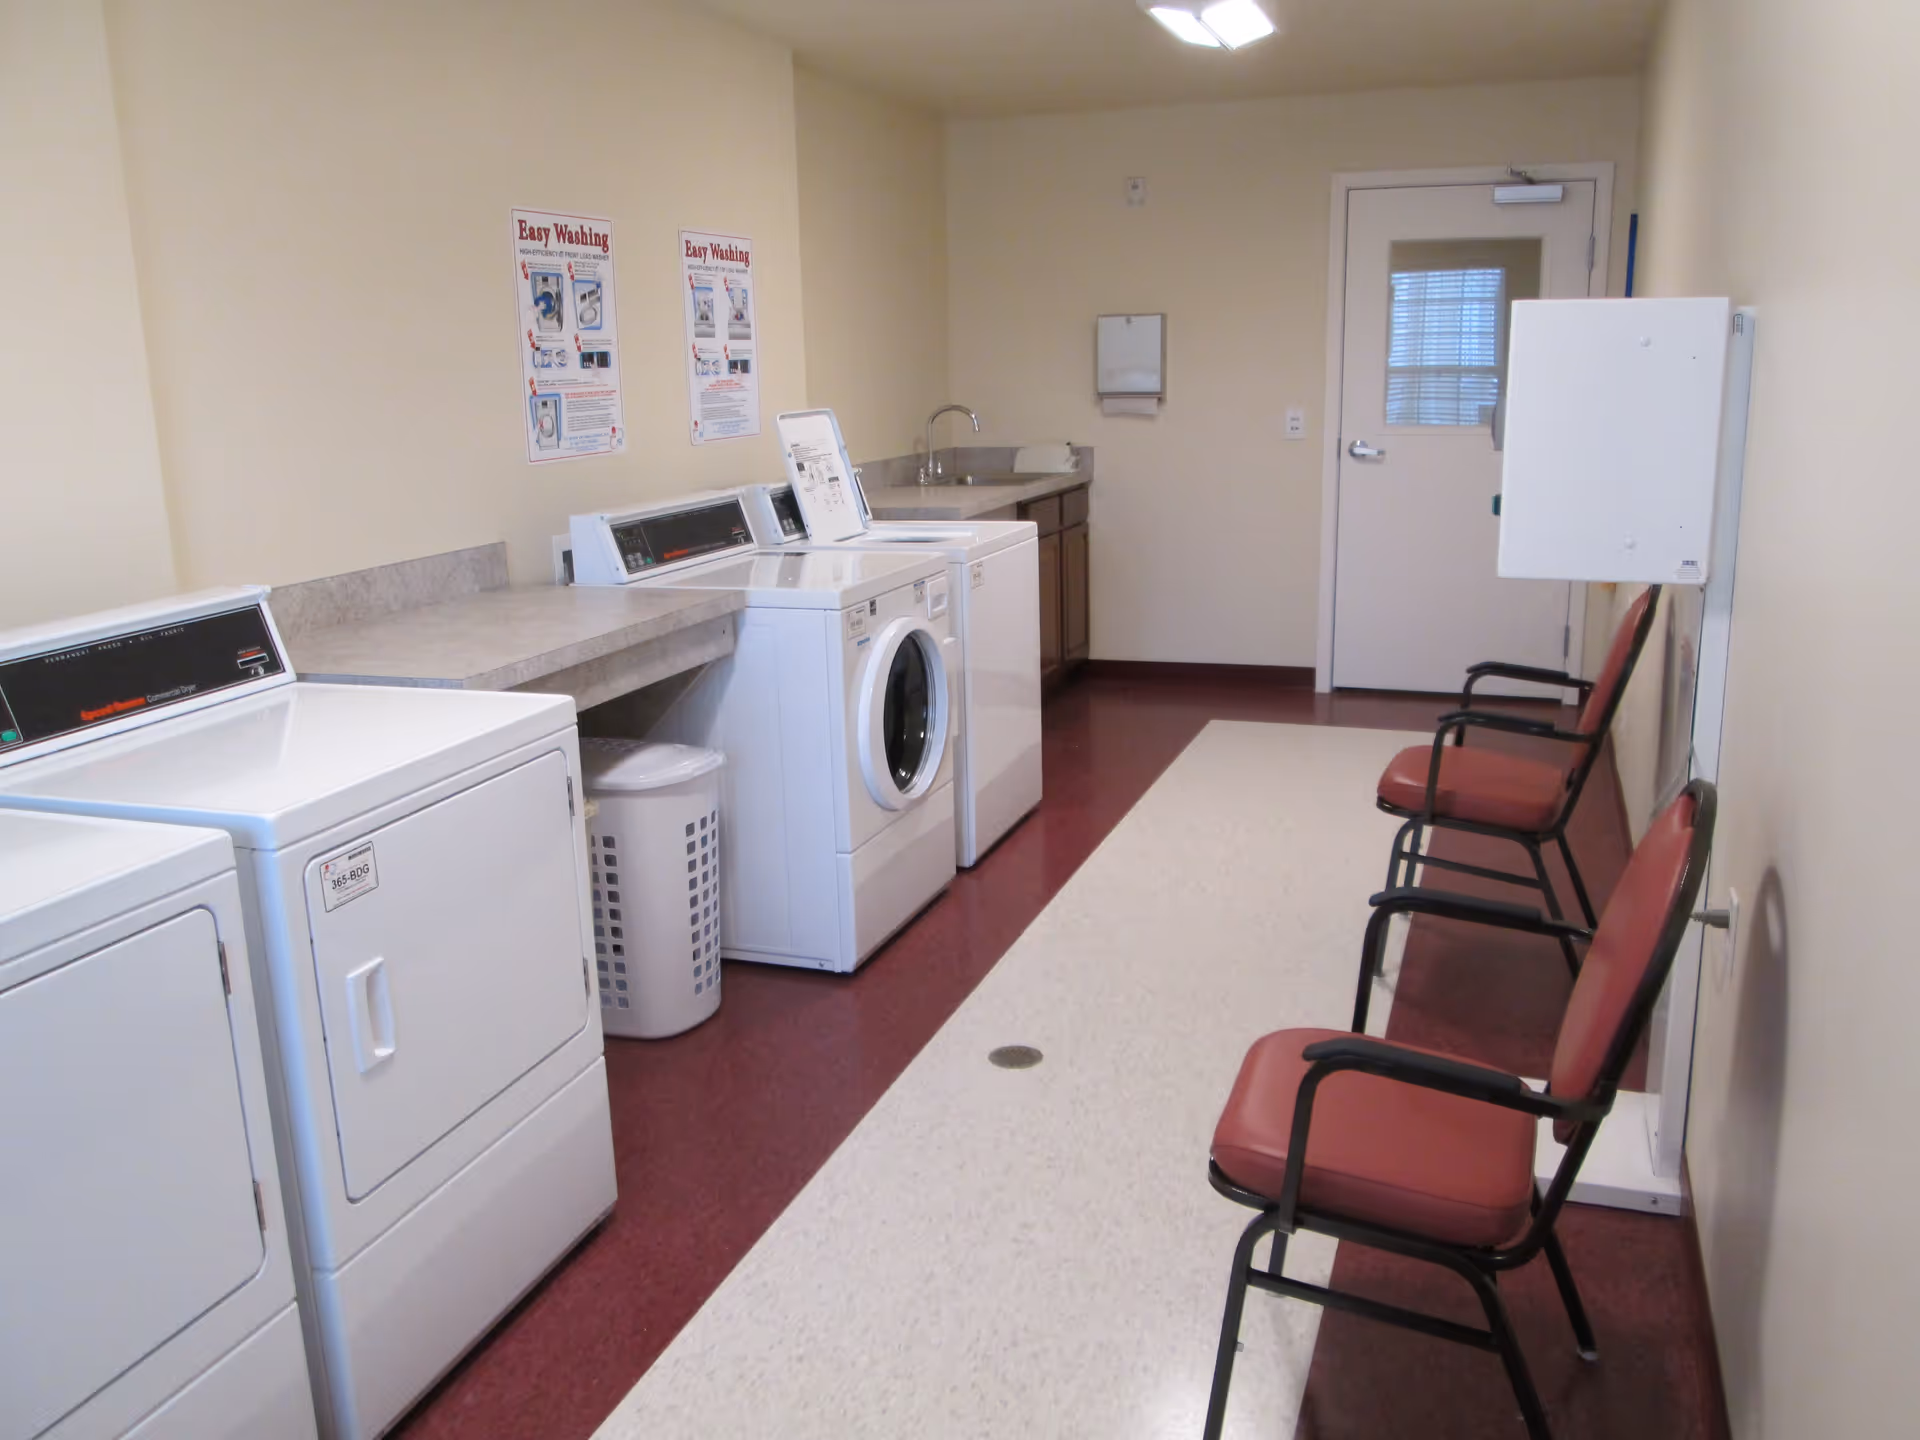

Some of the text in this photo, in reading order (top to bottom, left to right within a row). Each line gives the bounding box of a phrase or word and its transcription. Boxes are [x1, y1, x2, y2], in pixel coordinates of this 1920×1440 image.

[518, 219, 609, 253] Easy Washing
[685, 239, 750, 268] Easy Washing
[332, 863, 370, 890] 365-BDG
